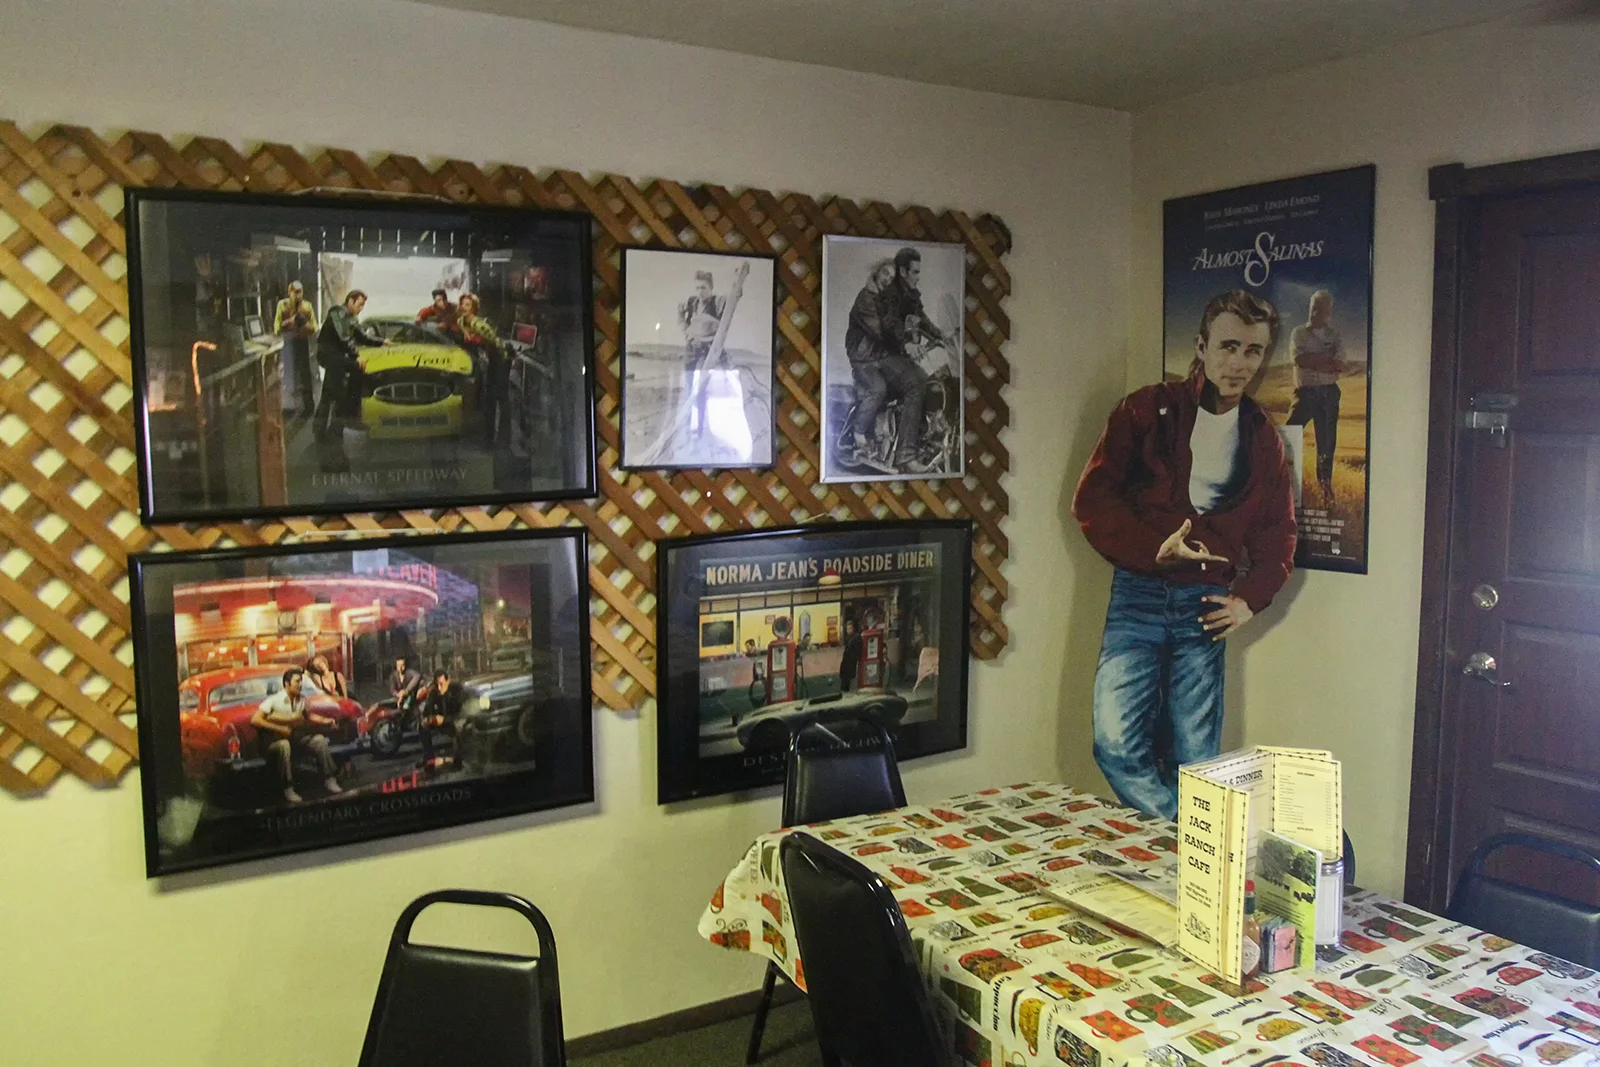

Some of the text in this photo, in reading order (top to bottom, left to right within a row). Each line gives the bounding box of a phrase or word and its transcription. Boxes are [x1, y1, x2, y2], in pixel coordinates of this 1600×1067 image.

[1192, 231, 1324, 287] ALMOST SALINAS
[706, 566, 762, 585] NORMA
[766, 557, 818, 579] JEAN'S
[897, 550, 934, 569] DINER
[1235, 769, 1263, 784] DINNER
[1192, 796, 1211, 812] THE
[1189, 815, 1212, 834] JACK
[1184, 833, 1216, 857] RANCH
[1188, 856, 1211, 875] CAFE
[1211, 997, 1263, 1018] Cappuccino
